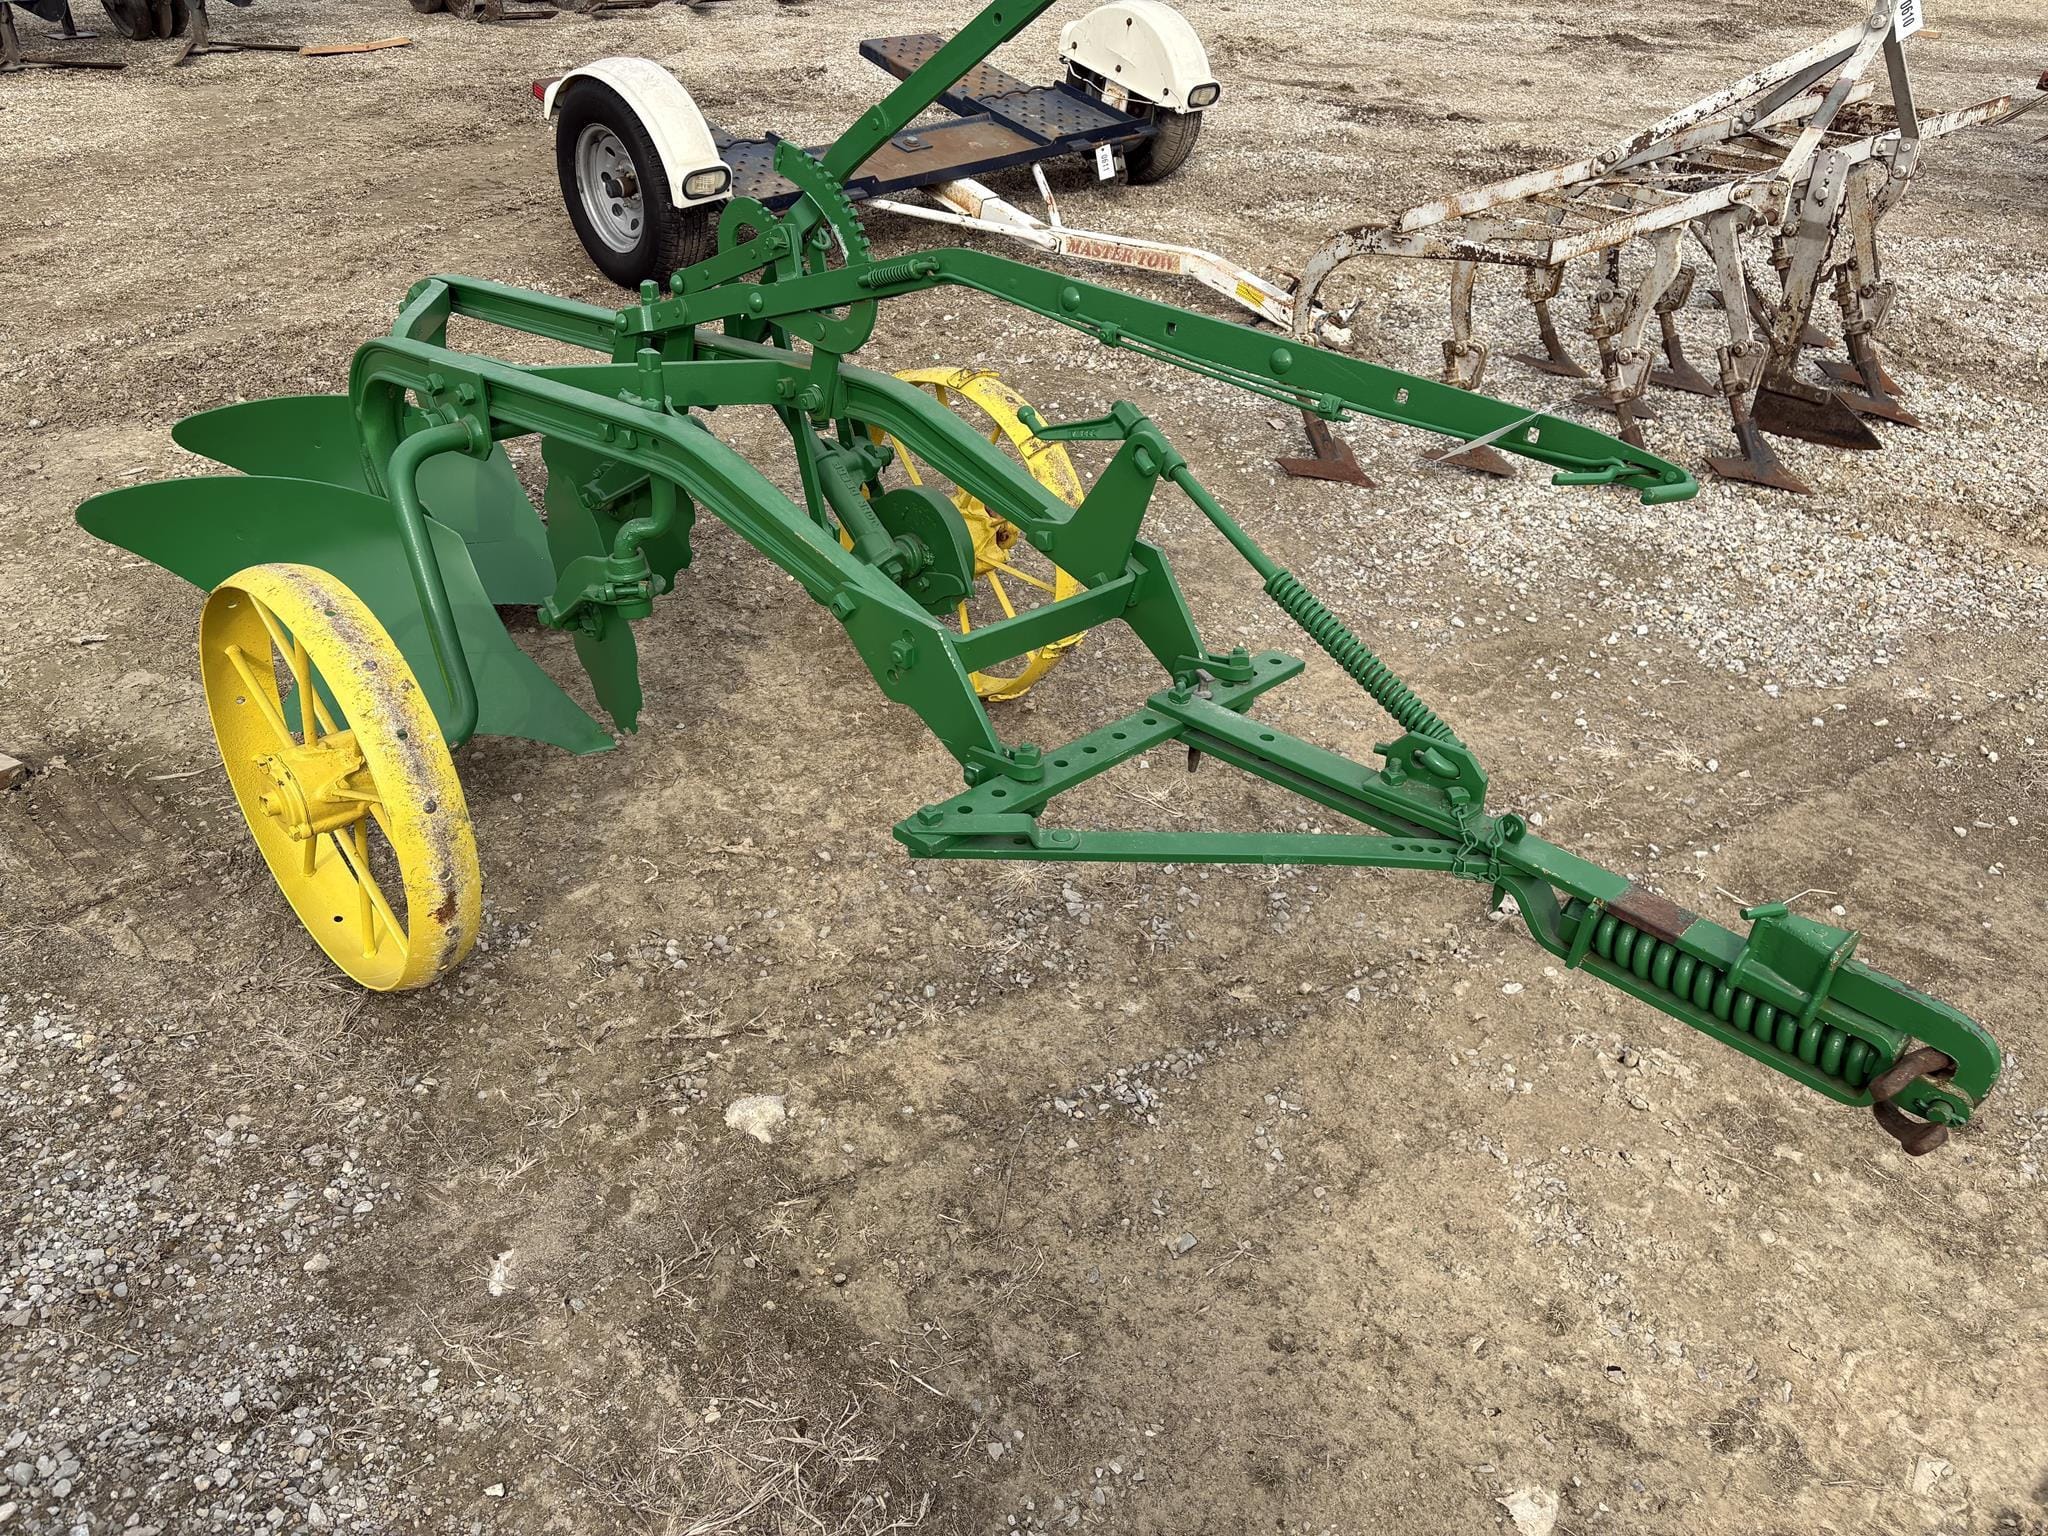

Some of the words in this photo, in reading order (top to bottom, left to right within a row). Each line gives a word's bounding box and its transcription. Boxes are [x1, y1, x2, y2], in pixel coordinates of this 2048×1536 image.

[1899, 0, 1915, 28] 0610
[1101, 154, 1110, 171] 0611
[1067, 239, 1134, 264] MASTER
[1137, 249, 1178, 271] TOW
